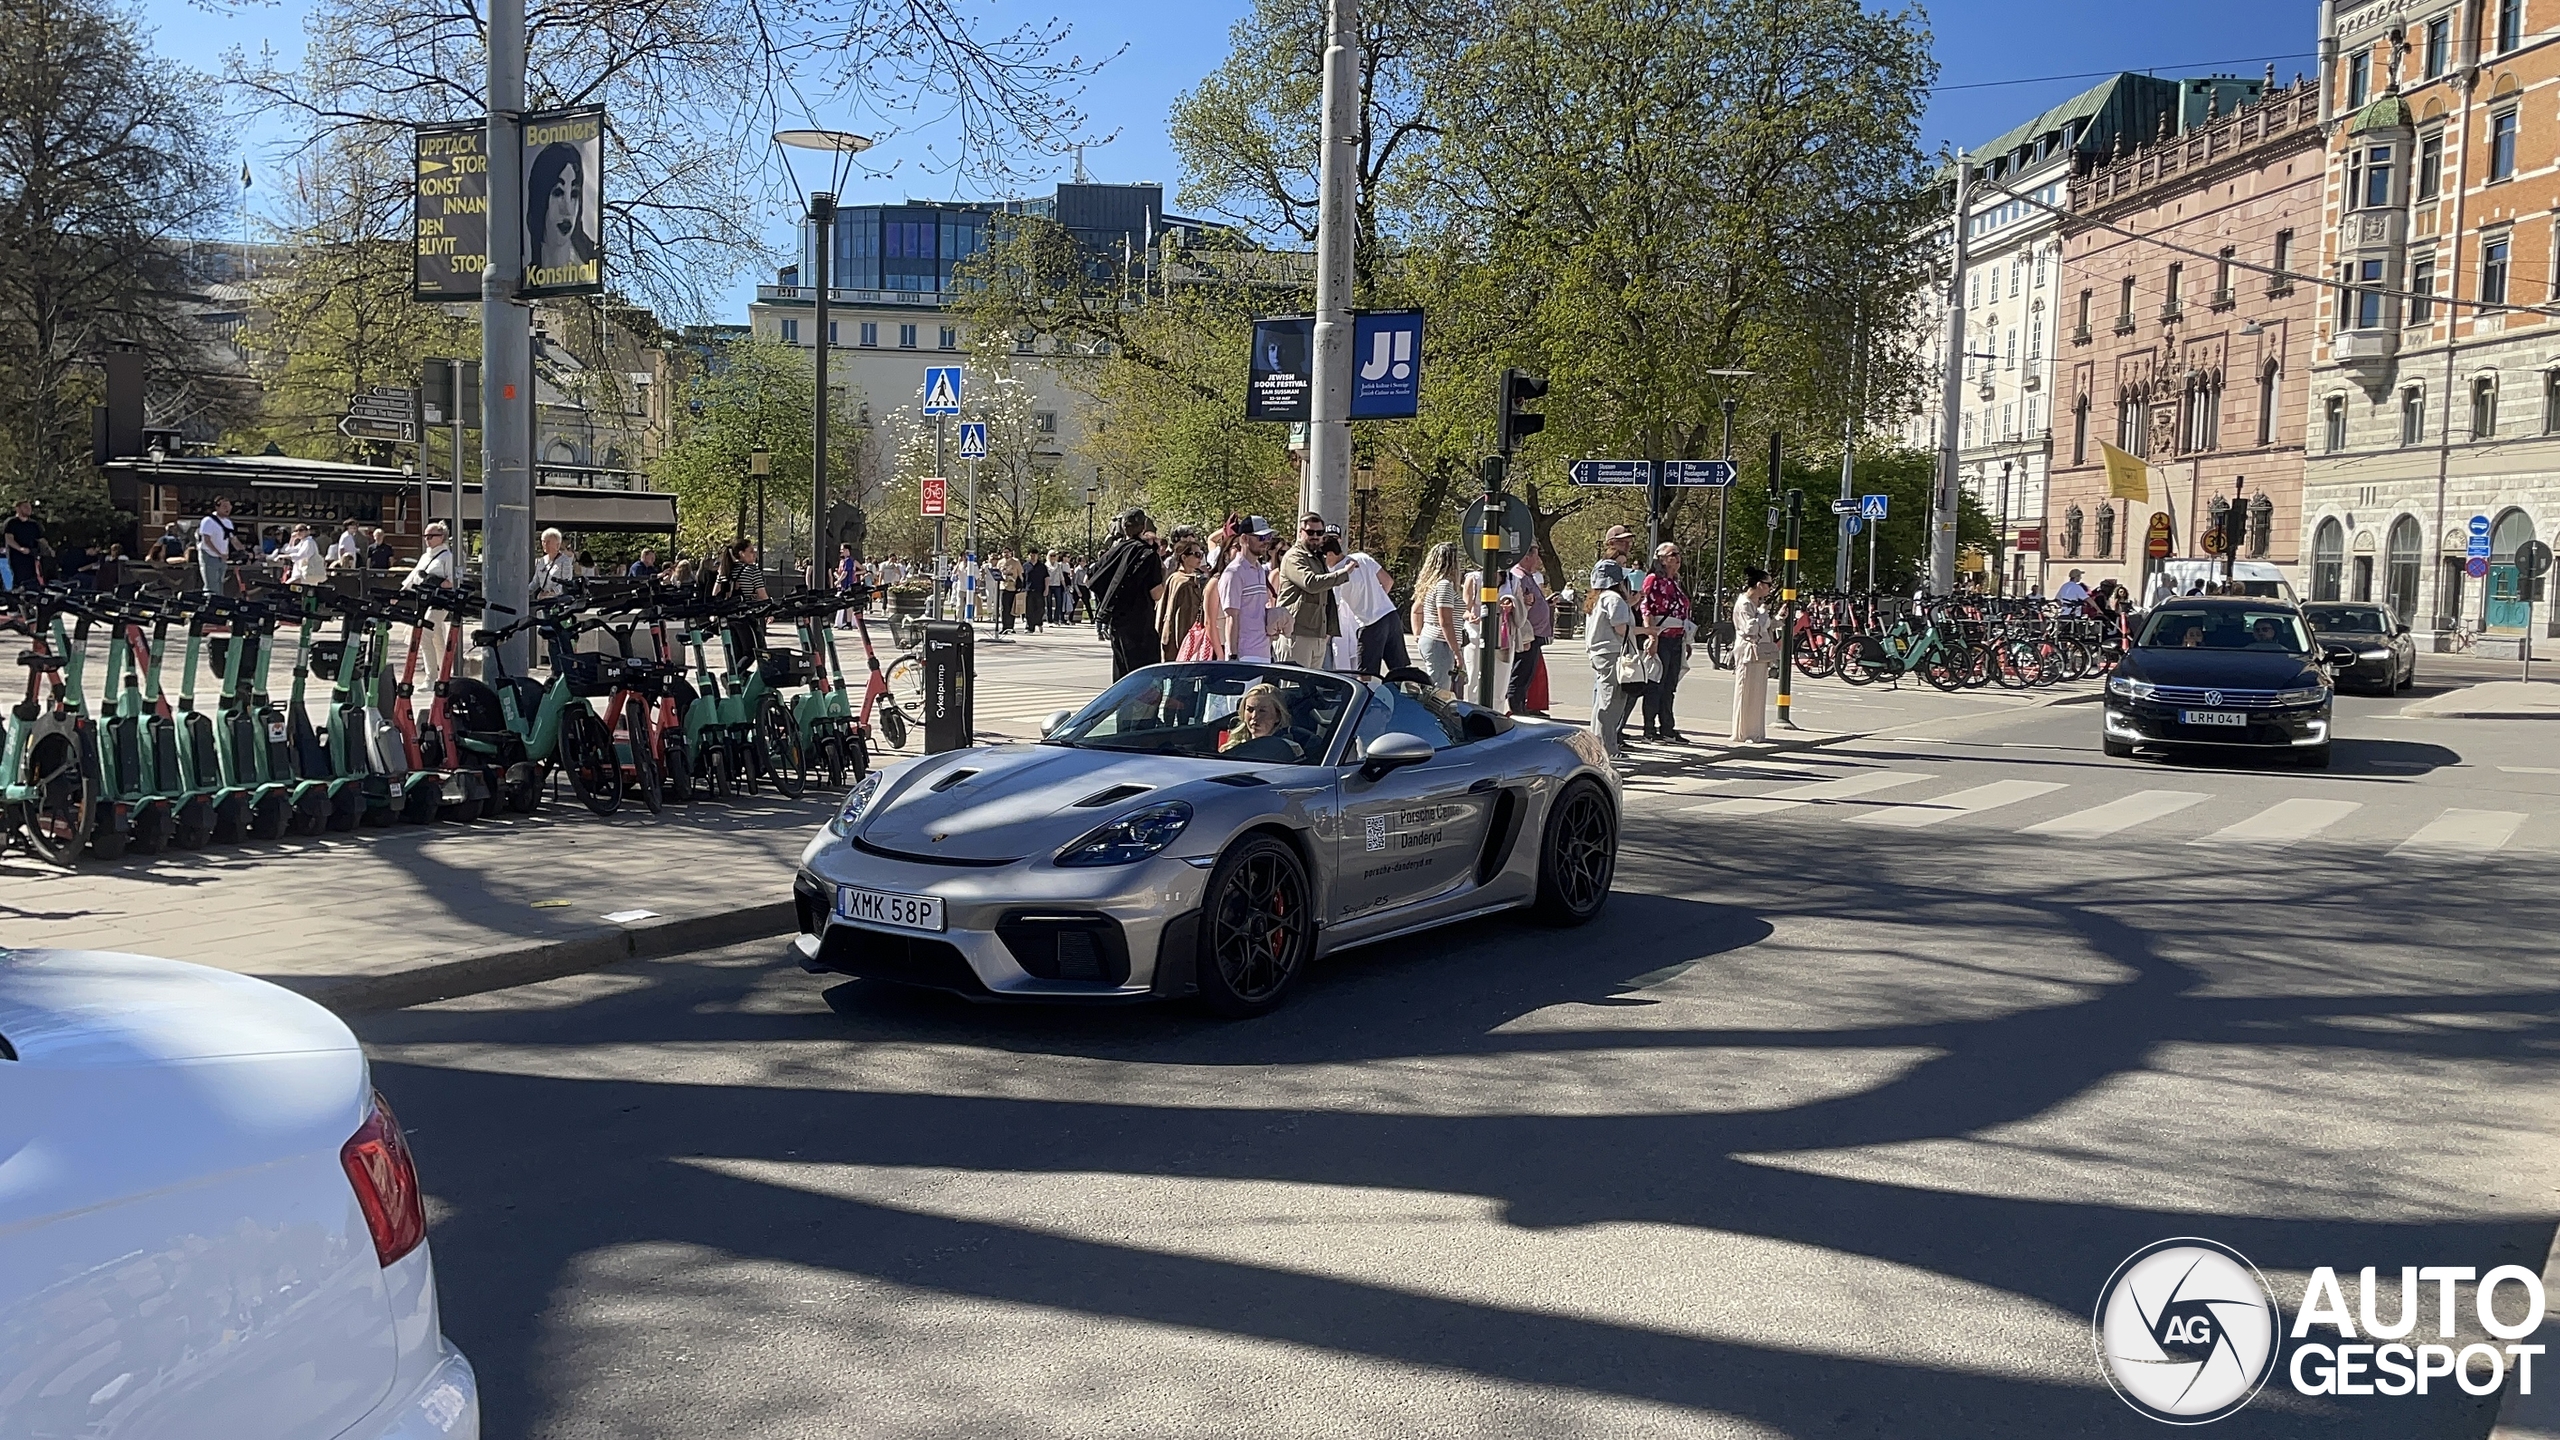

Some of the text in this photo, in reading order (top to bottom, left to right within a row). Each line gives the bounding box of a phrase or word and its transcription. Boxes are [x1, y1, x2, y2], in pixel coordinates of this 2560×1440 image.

[527, 119, 597, 146] Bonniers
[419, 133, 477, 157] UPPTÄCK
[451, 156, 486, 174] STOR
[419, 177, 462, 196] KONST
[444, 196, 486, 215] INNAN
[418, 218, 443, 236] DEN
[418, 237, 457, 255] BLIVIT
[451, 255, 486, 273] STOR
[526, 259, 598, 286] Konsthall
[1360, 331, 1412, 380] J!
[1254, 380, 1308, 389] BOOK FESTIVAL
[1267, 373, 1295, 381] JEWISH
[322, 653, 338, 662] Bolt
[936, 664, 945, 718] Cykelpump
[2190, 713, 2241, 725] LRH 041
[1400, 806, 1435, 824] Porsche
[1401, 828, 1442, 849] Danderyd
[1364, 858, 1433, 880] porsche-danderyd.se
[850, 891, 932, 925] XMK 58P
